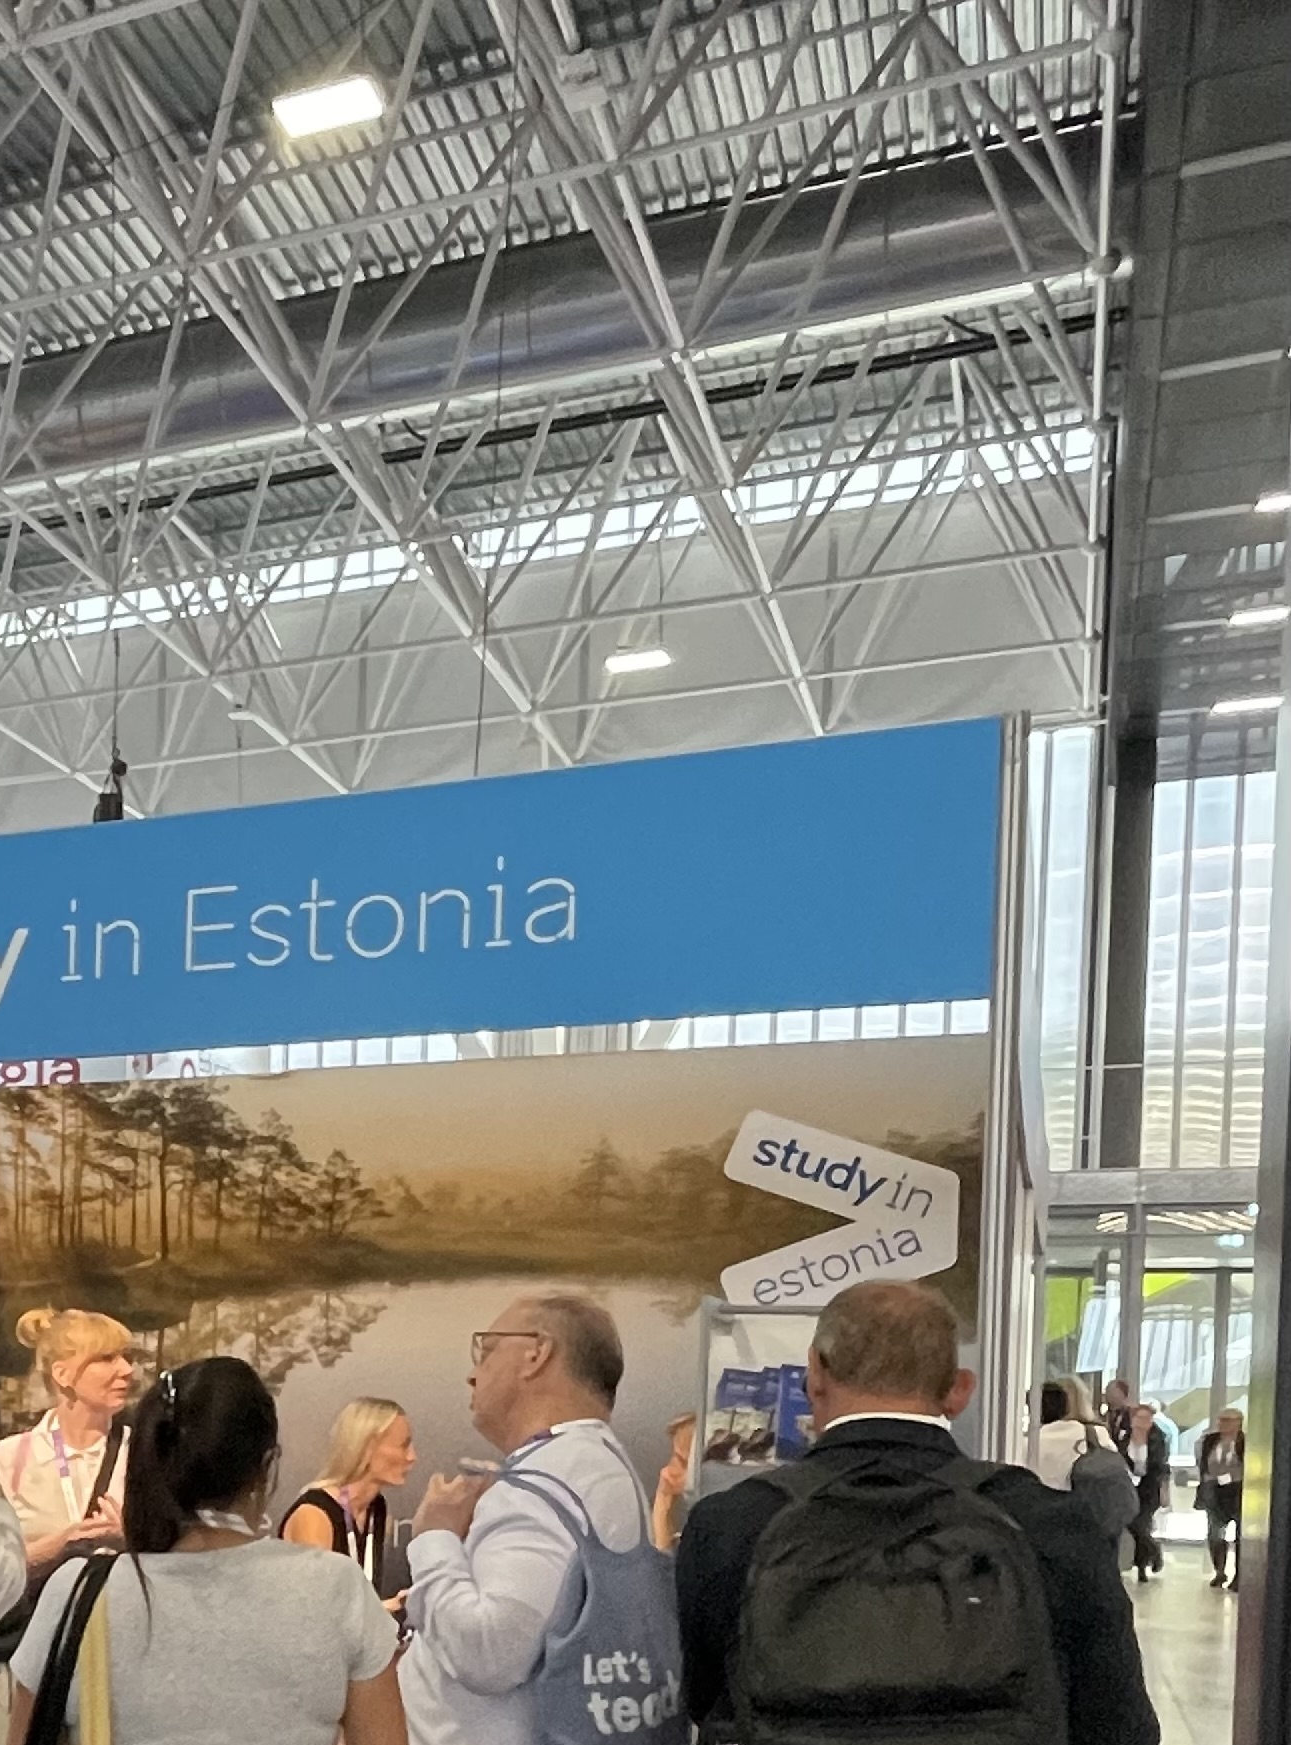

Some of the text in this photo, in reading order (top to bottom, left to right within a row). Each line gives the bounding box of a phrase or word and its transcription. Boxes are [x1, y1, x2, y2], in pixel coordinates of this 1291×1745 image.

[59, 898, 141, 984] in
[184, 855, 578, 974] Estonia
[753, 1139, 933, 1219] study in
[753, 1228, 923, 1305] estonia
